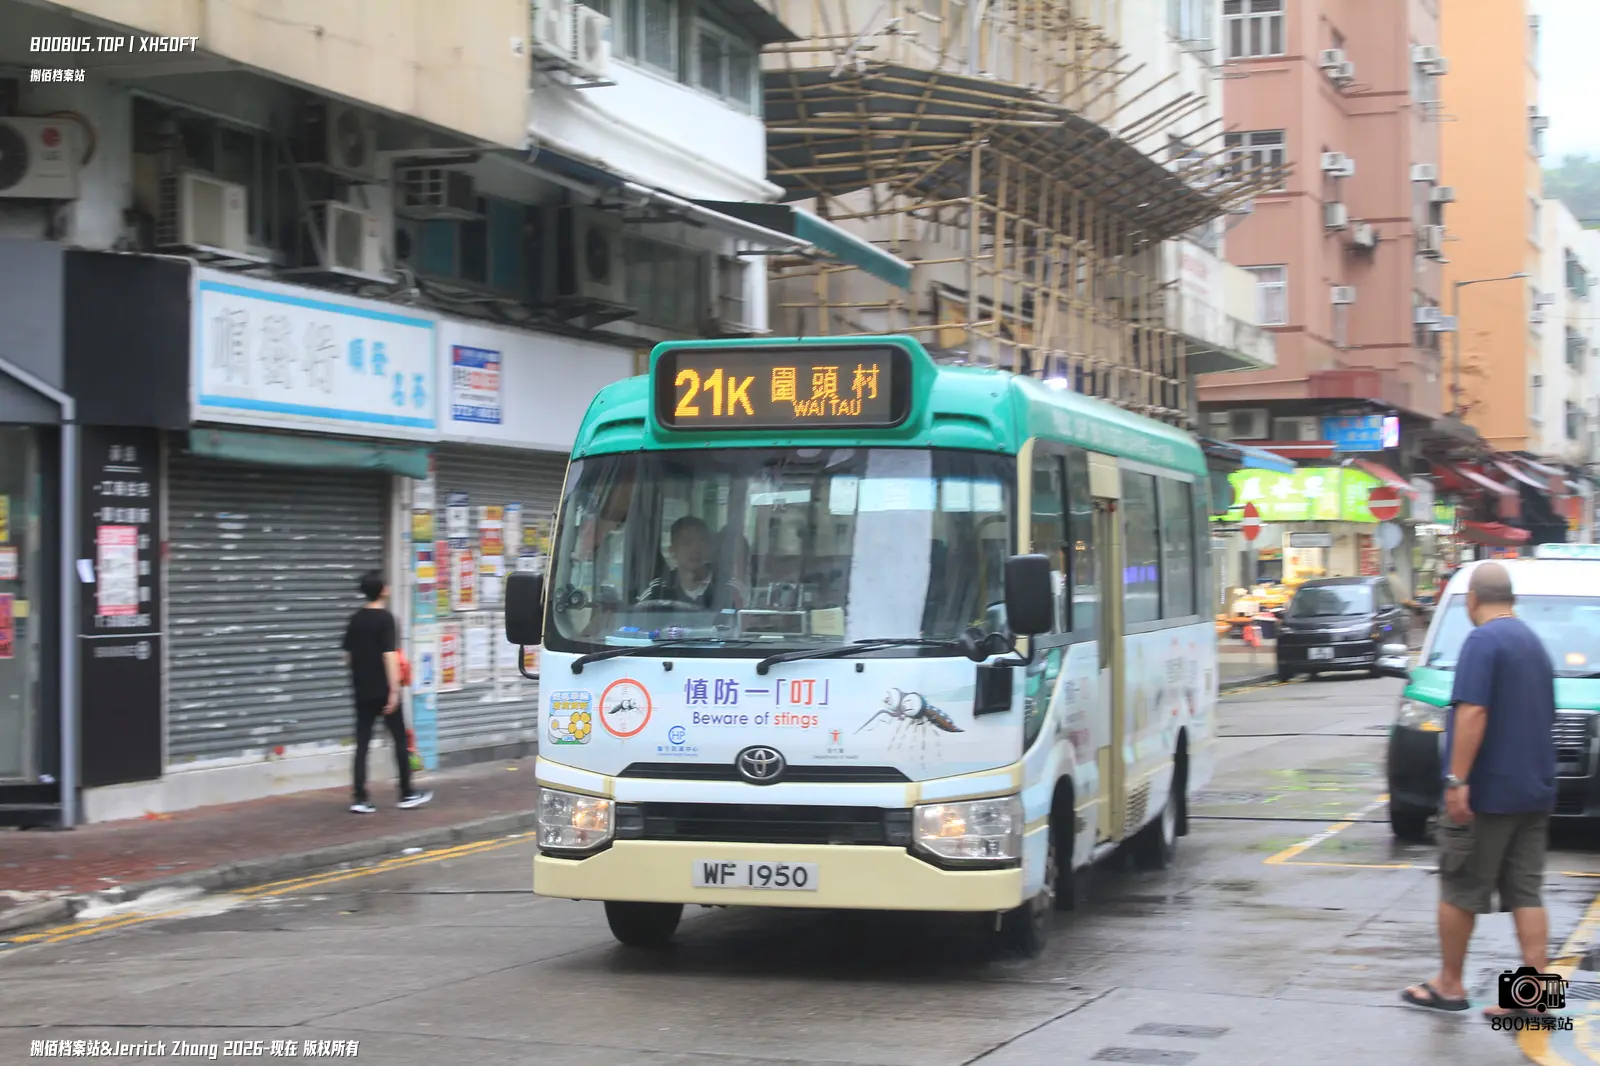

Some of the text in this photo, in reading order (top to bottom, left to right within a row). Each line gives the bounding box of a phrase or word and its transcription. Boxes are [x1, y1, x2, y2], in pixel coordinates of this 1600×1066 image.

[674, 368, 755, 417] 21K
[791, 399, 862, 417] WAI TAU
[692, 711, 819, 729] Beware of stings
[703, 862, 808, 888] WF 1950
